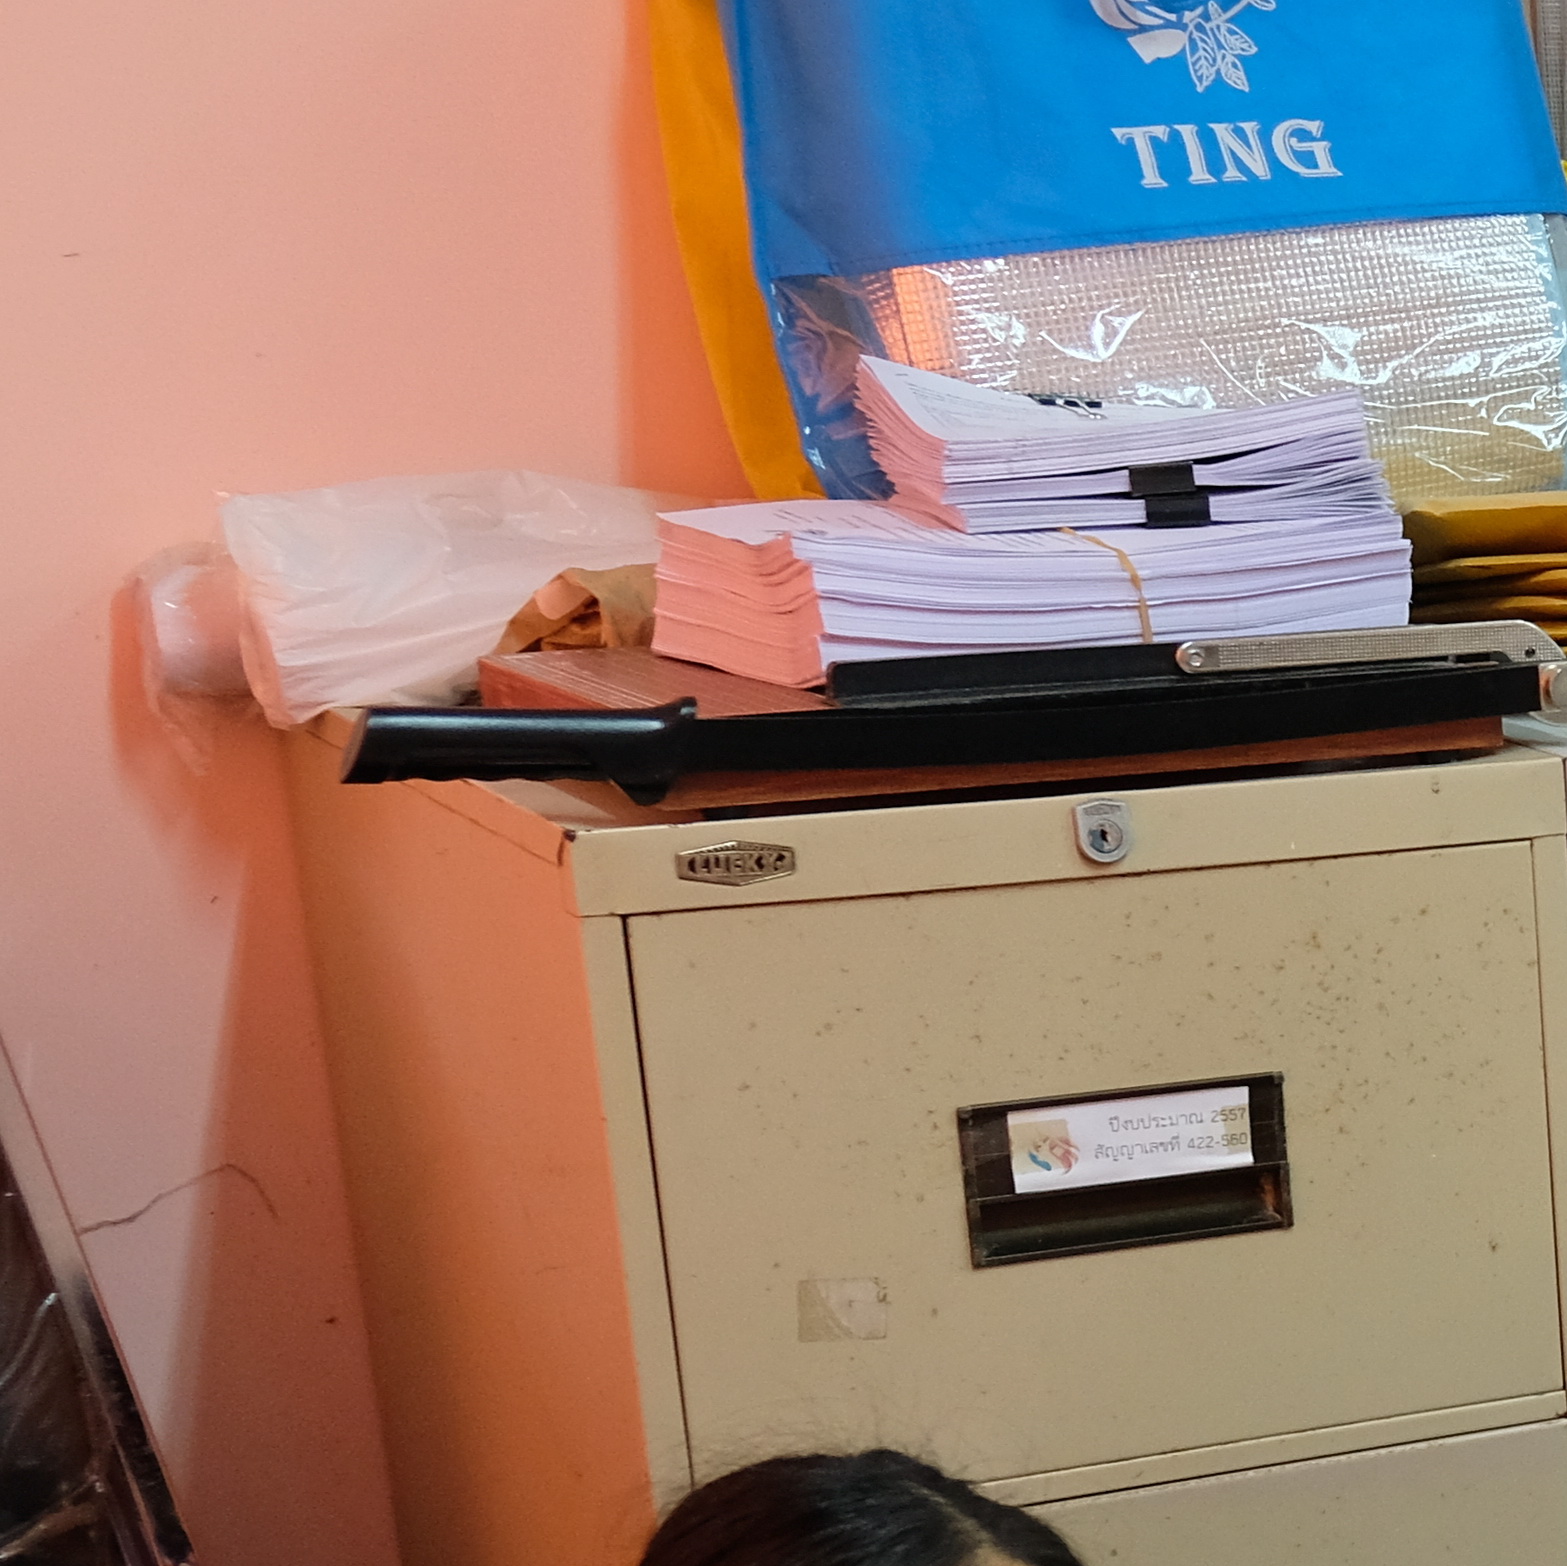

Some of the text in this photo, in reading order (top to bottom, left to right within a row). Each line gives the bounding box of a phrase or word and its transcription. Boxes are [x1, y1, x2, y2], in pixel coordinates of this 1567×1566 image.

[1110, 118, 1344, 188] TING
[1109, 1107, 1247, 1133] ปีงบประมาณ 2557
[1094, 1132, 1249, 1162] สัญญาเลขที่ 422-560
